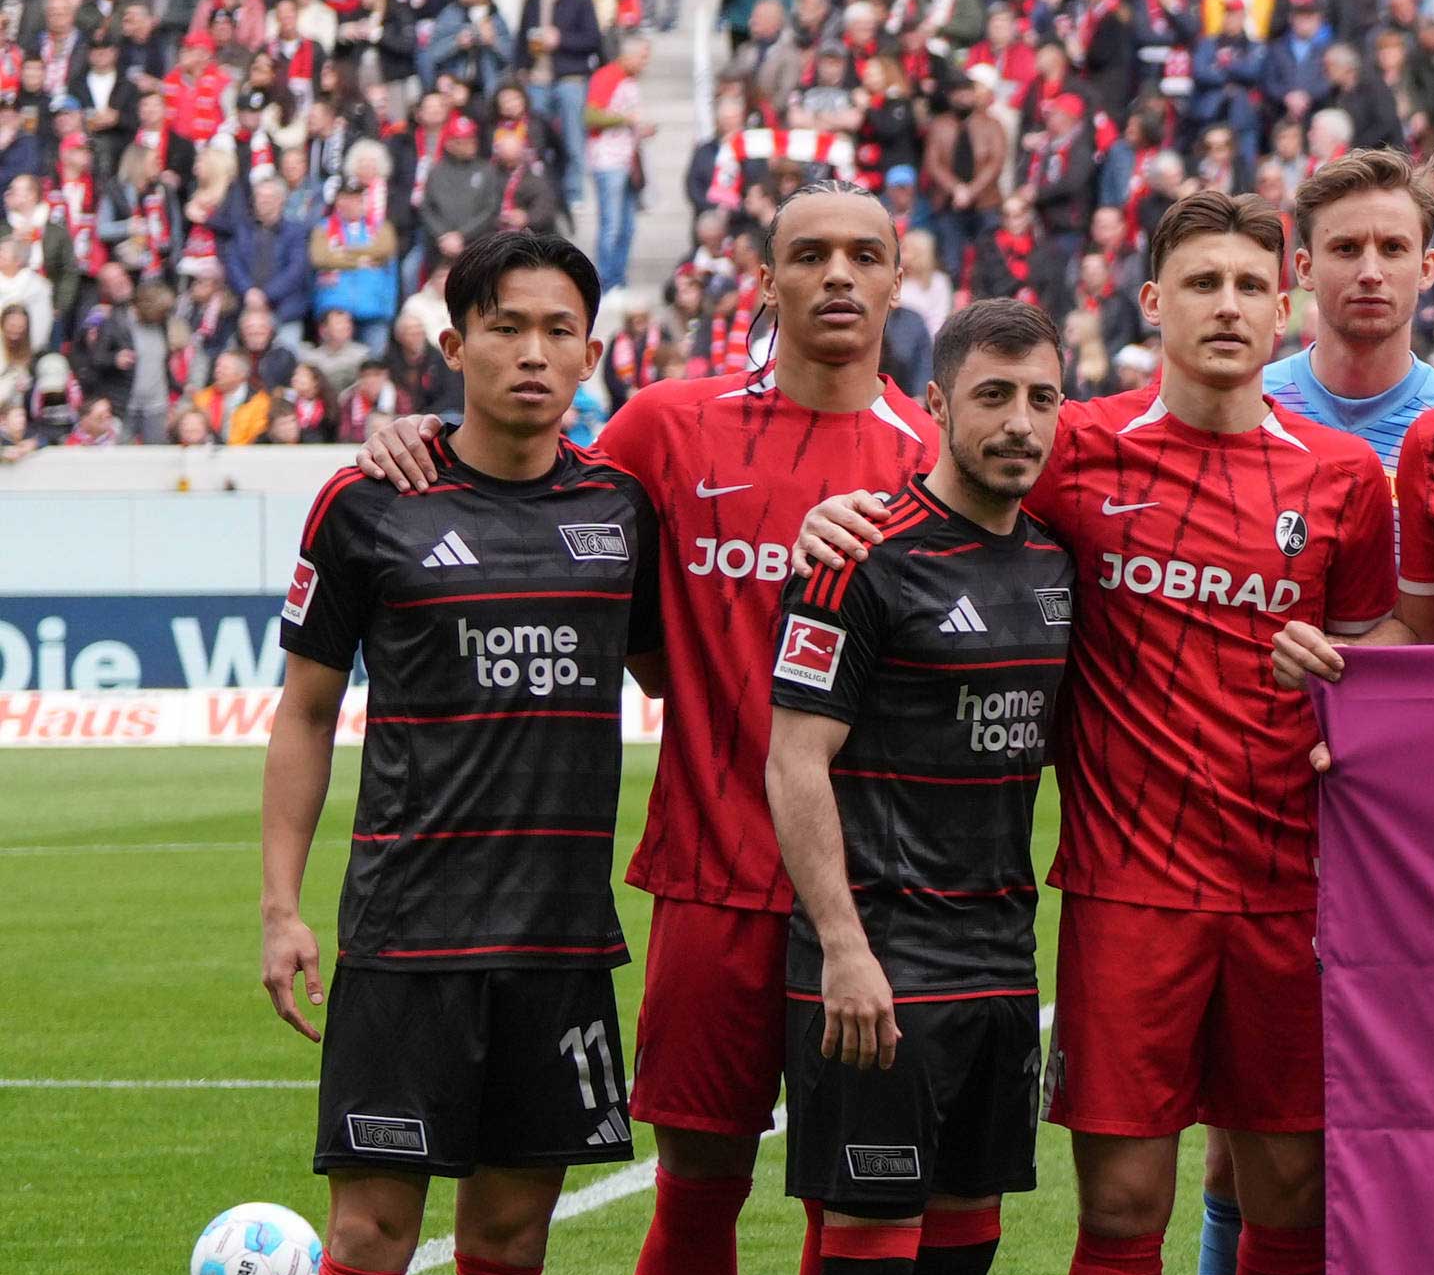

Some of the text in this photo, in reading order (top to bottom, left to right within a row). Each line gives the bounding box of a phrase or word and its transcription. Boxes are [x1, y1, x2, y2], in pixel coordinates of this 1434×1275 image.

[688, 537, 793, 582] JOB
[1099, 552, 1302, 613] JOBRAD
[457, 618, 578, 656] home
[476, 652, 519, 687] to
[956, 684, 1045, 721] home
[970, 721, 1008, 752] to
[559, 1019, 620, 1110] 11
